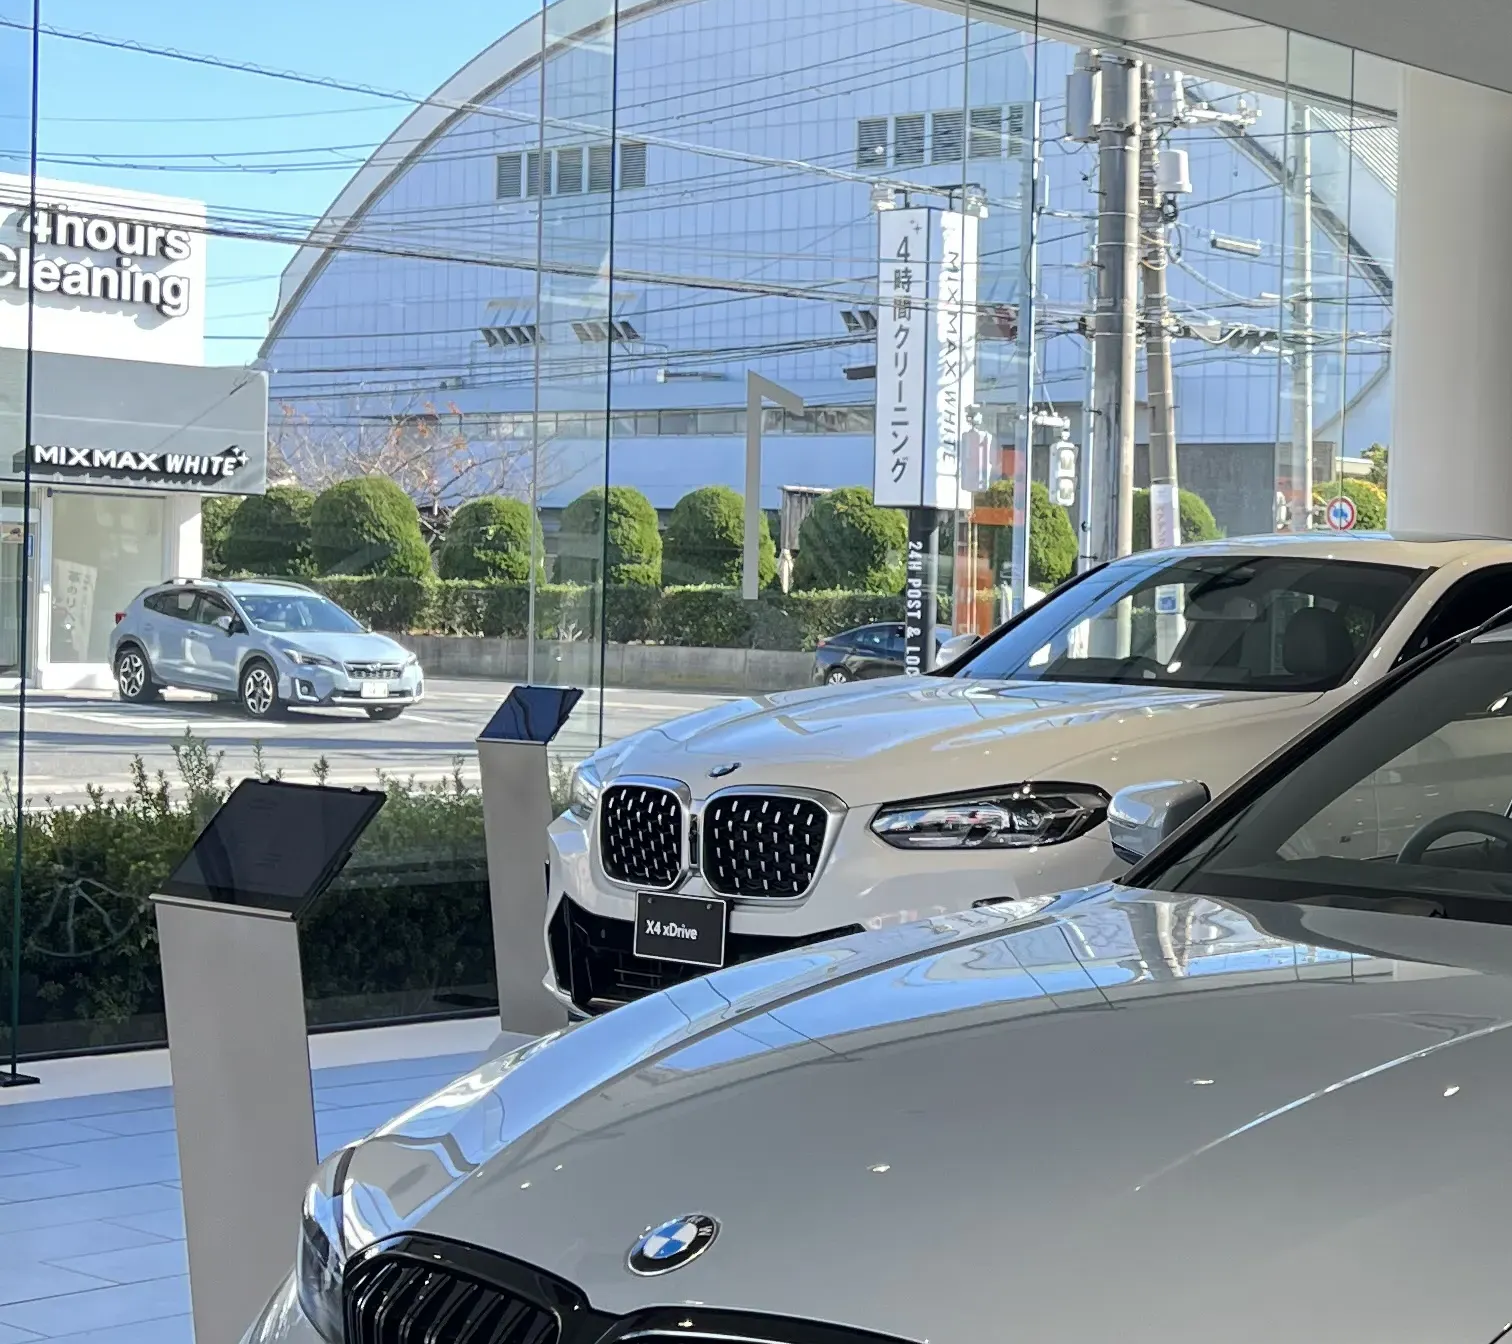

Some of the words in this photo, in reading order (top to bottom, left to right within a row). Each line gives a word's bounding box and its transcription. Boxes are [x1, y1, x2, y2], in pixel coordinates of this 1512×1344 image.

[891, 236, 913, 483] 4時間クリーニング
[942, 390, 957, 462] WHITE
[165, 453, 236, 476] WHITE
[908, 541, 923, 571] 24H
[906, 578, 922, 619] POST
[906, 626, 921, 639] &
[645, 919, 661, 935] X4
[663, 922, 698, 940] xDrive
